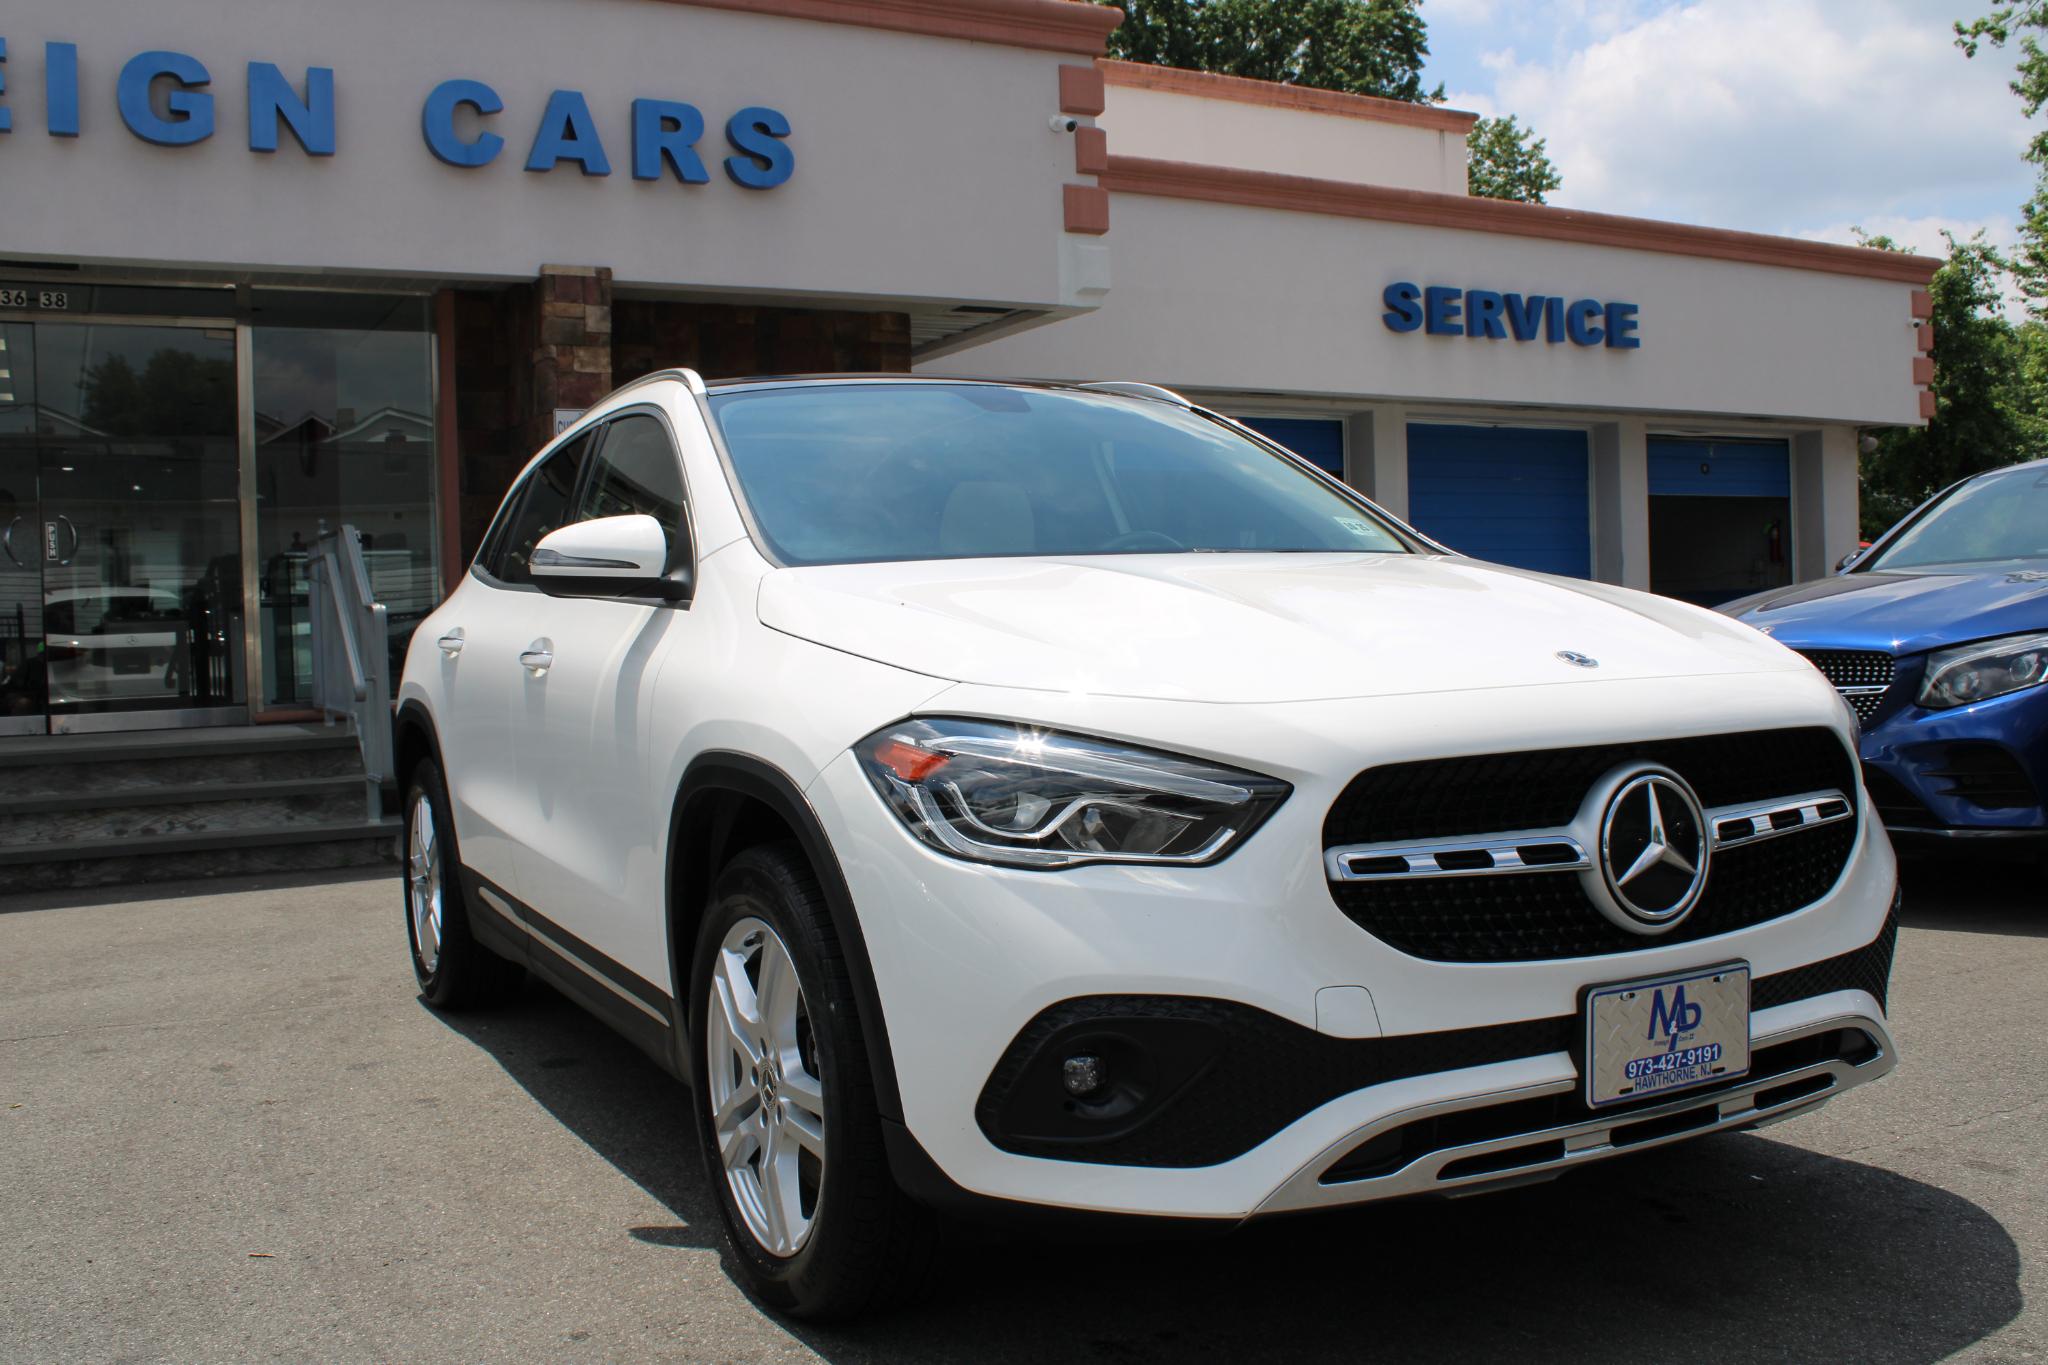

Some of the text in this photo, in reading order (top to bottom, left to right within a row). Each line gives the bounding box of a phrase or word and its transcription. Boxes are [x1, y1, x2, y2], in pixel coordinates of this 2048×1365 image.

[0, 36, 795, 190] IGN CARS
[1382, 282, 1640, 349] SERVICE
[1628, 1044, 1719, 1078] 973-427-9191
[1700, 1064, 1713, 1078] NJ
